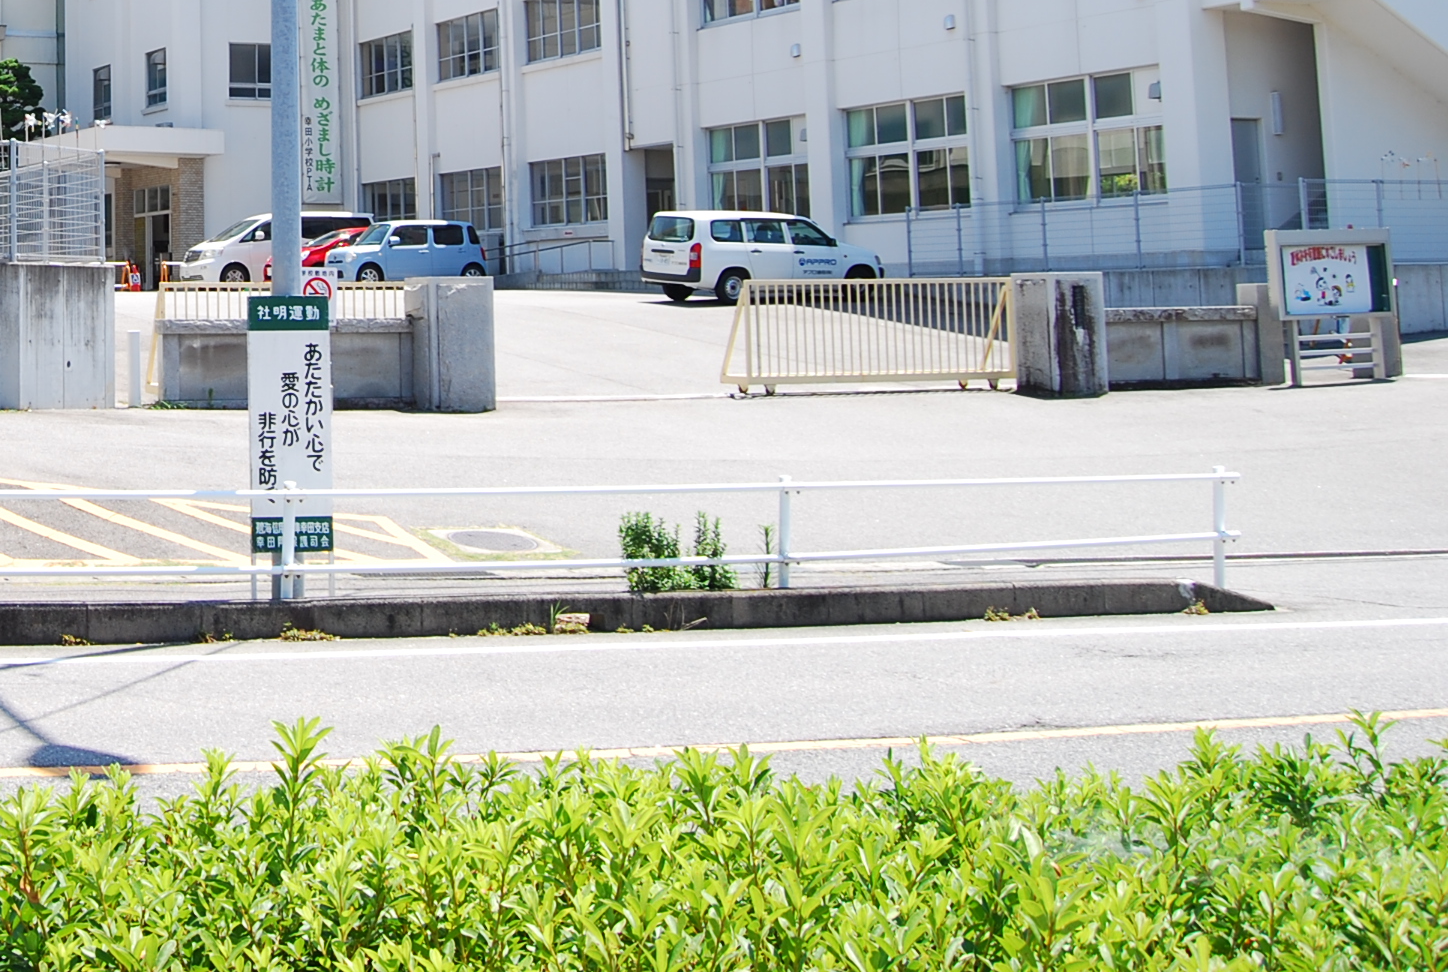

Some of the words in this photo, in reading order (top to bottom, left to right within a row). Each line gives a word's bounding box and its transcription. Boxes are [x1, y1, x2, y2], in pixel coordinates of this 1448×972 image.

[304, 116, 314, 191] 幸田小学校PTA
[313, 96, 336, 193] めざまし時計
[256, 305, 320, 321] 社明運動
[281, 371, 301, 447] 愛の心が
[304, 342, 324, 472] あたたかい心で
